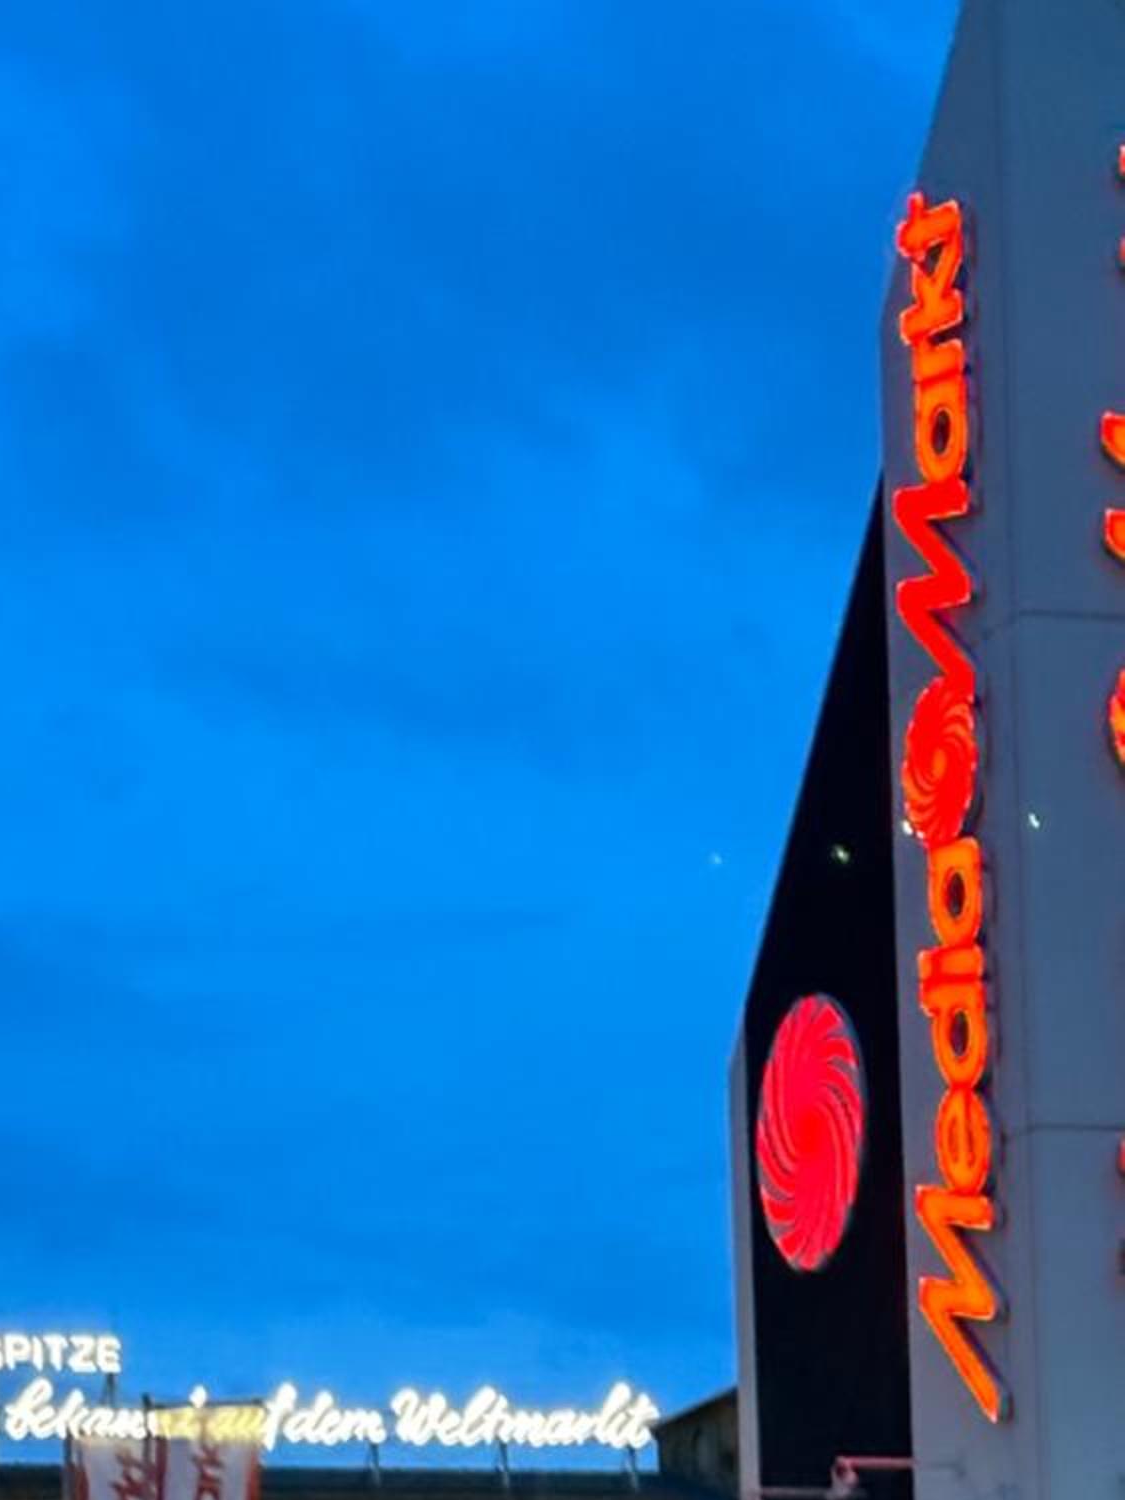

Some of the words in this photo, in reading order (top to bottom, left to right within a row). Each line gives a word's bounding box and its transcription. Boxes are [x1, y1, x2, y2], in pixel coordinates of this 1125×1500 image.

[915, 836, 999, 1423] Media
[283, 1388, 385, 1443] dem
[390, 1382, 659, 1449] Weltmarkt
